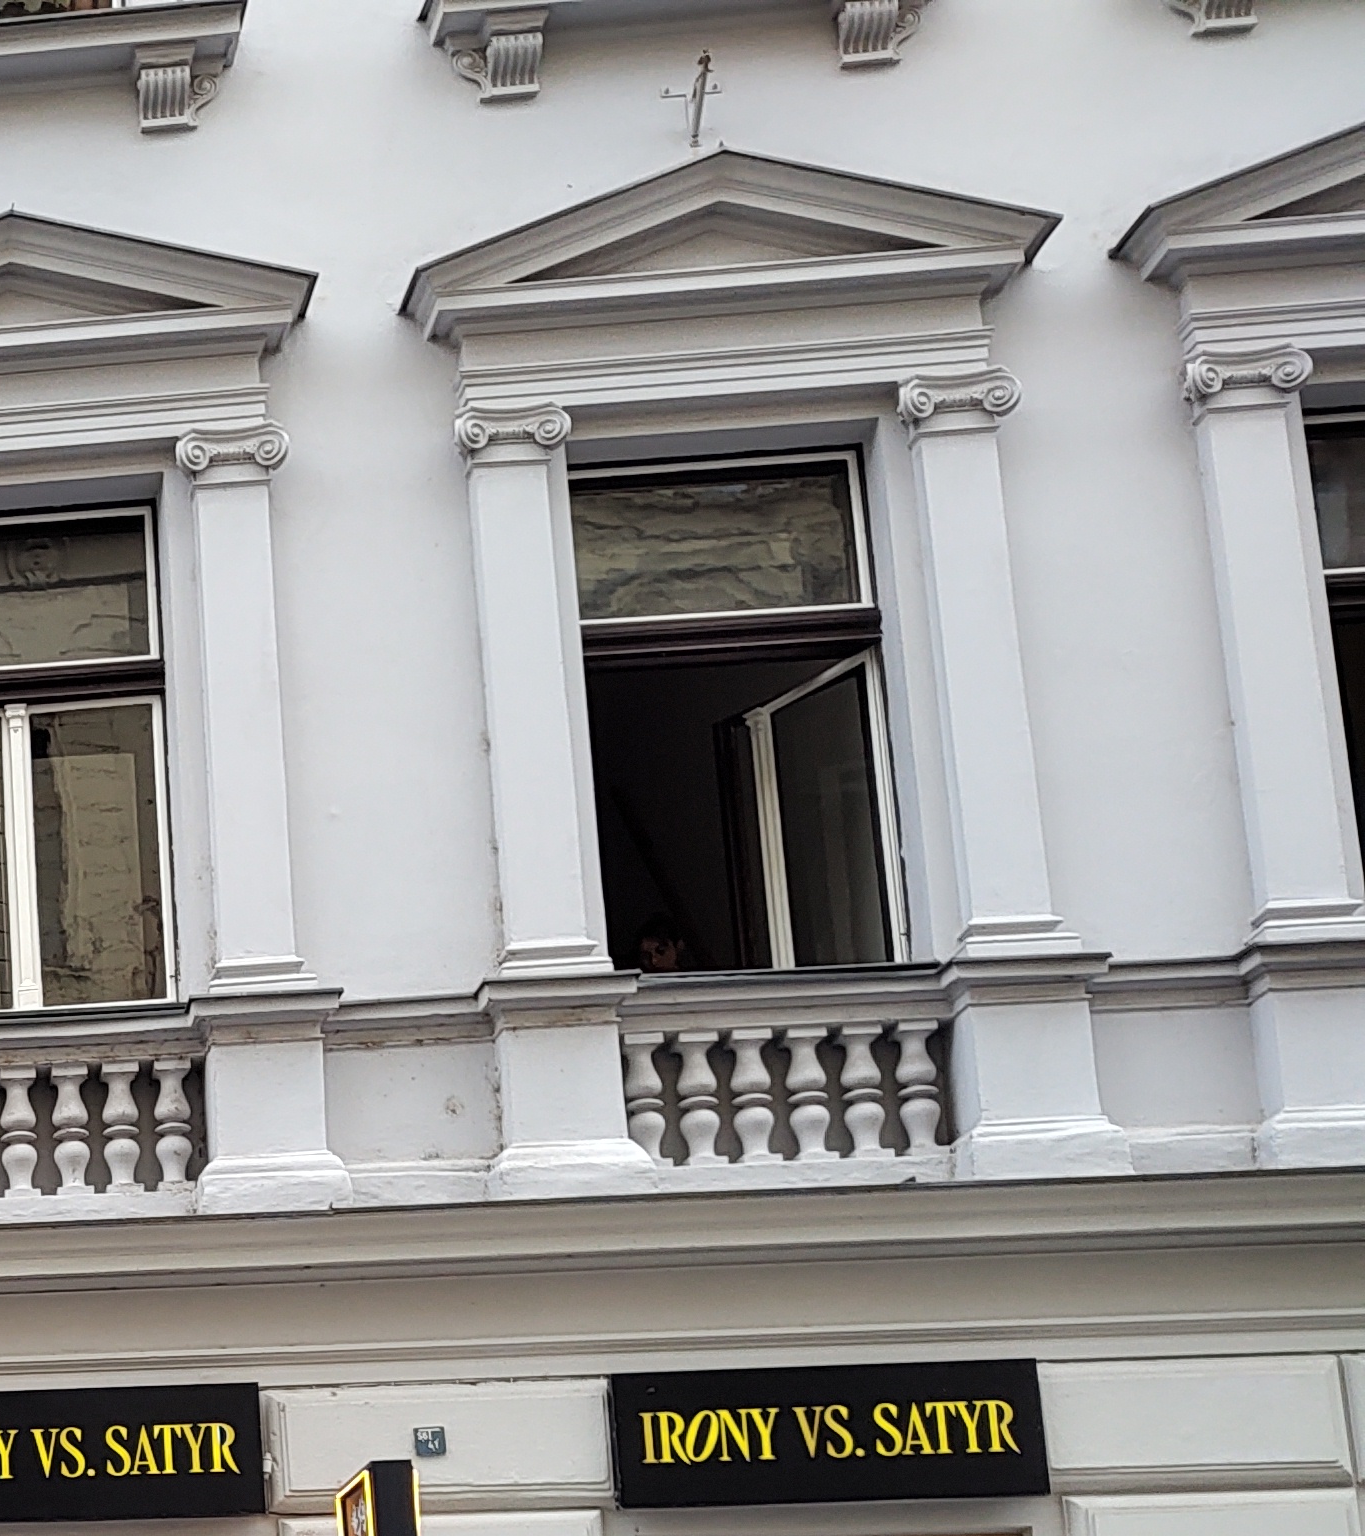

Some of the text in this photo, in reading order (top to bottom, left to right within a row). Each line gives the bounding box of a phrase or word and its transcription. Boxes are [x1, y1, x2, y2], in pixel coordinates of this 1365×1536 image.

[30, 1427, 95, 1478] VS.
[105, 1422, 241, 1476] SATYR
[638, 1399, 1021, 1465] IRONY VS. SATYR
